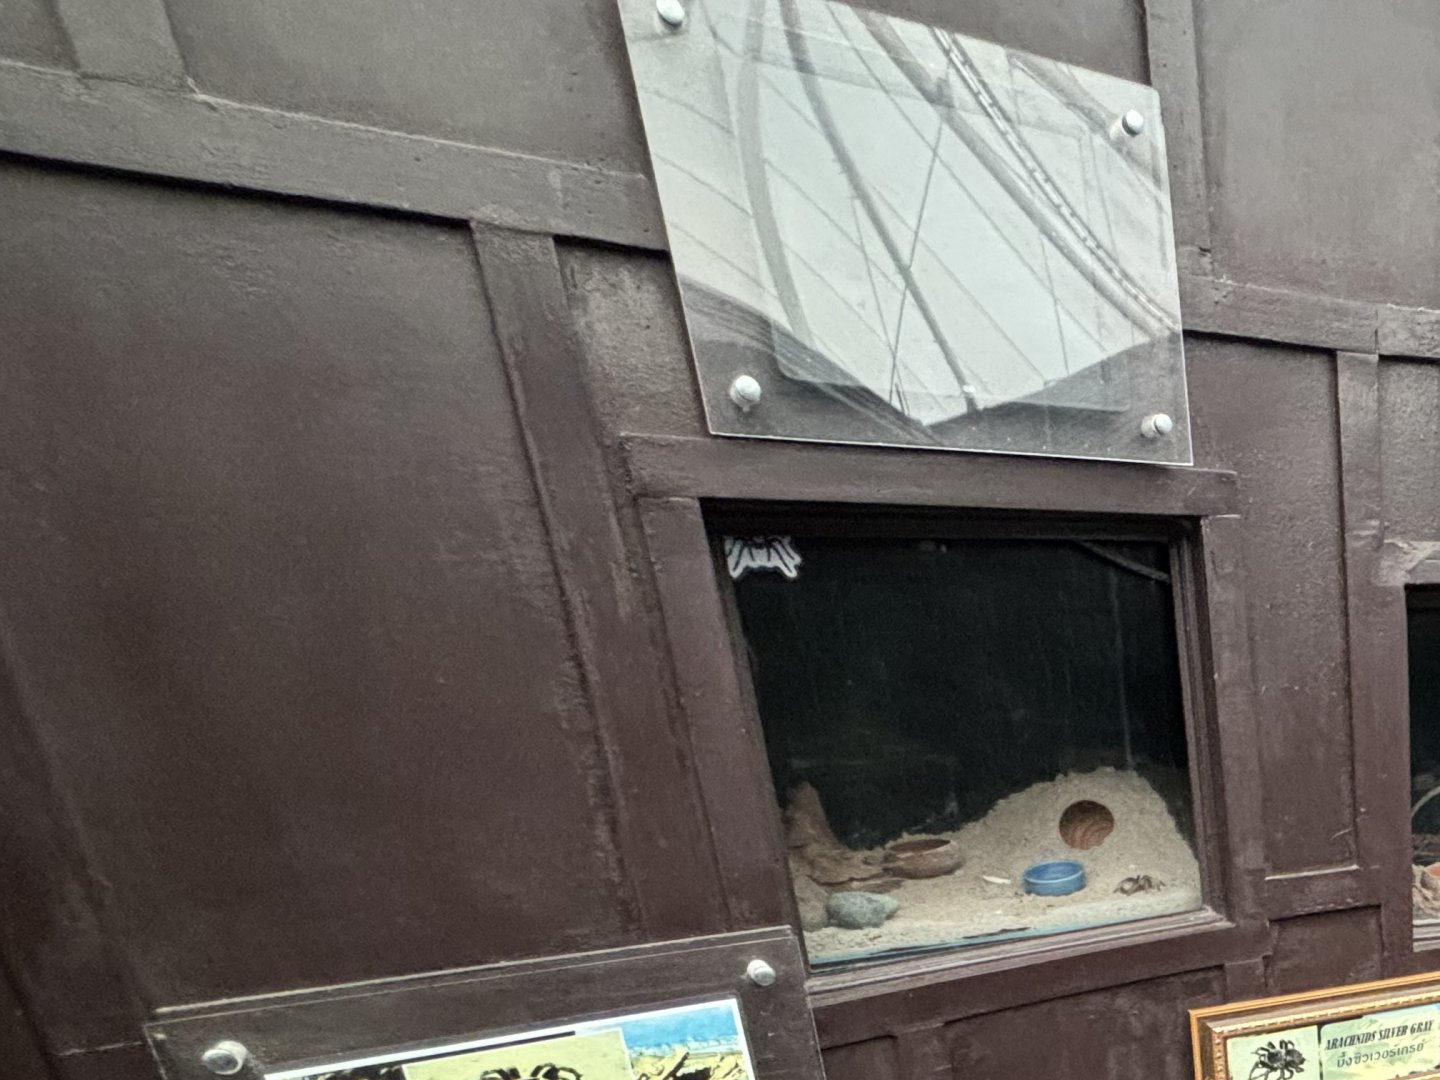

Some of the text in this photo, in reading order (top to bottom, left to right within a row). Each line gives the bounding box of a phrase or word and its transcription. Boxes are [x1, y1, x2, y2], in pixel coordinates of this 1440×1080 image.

[1325, 1020, 1434, 1051] ARACHNIDS SILVER GRAY
